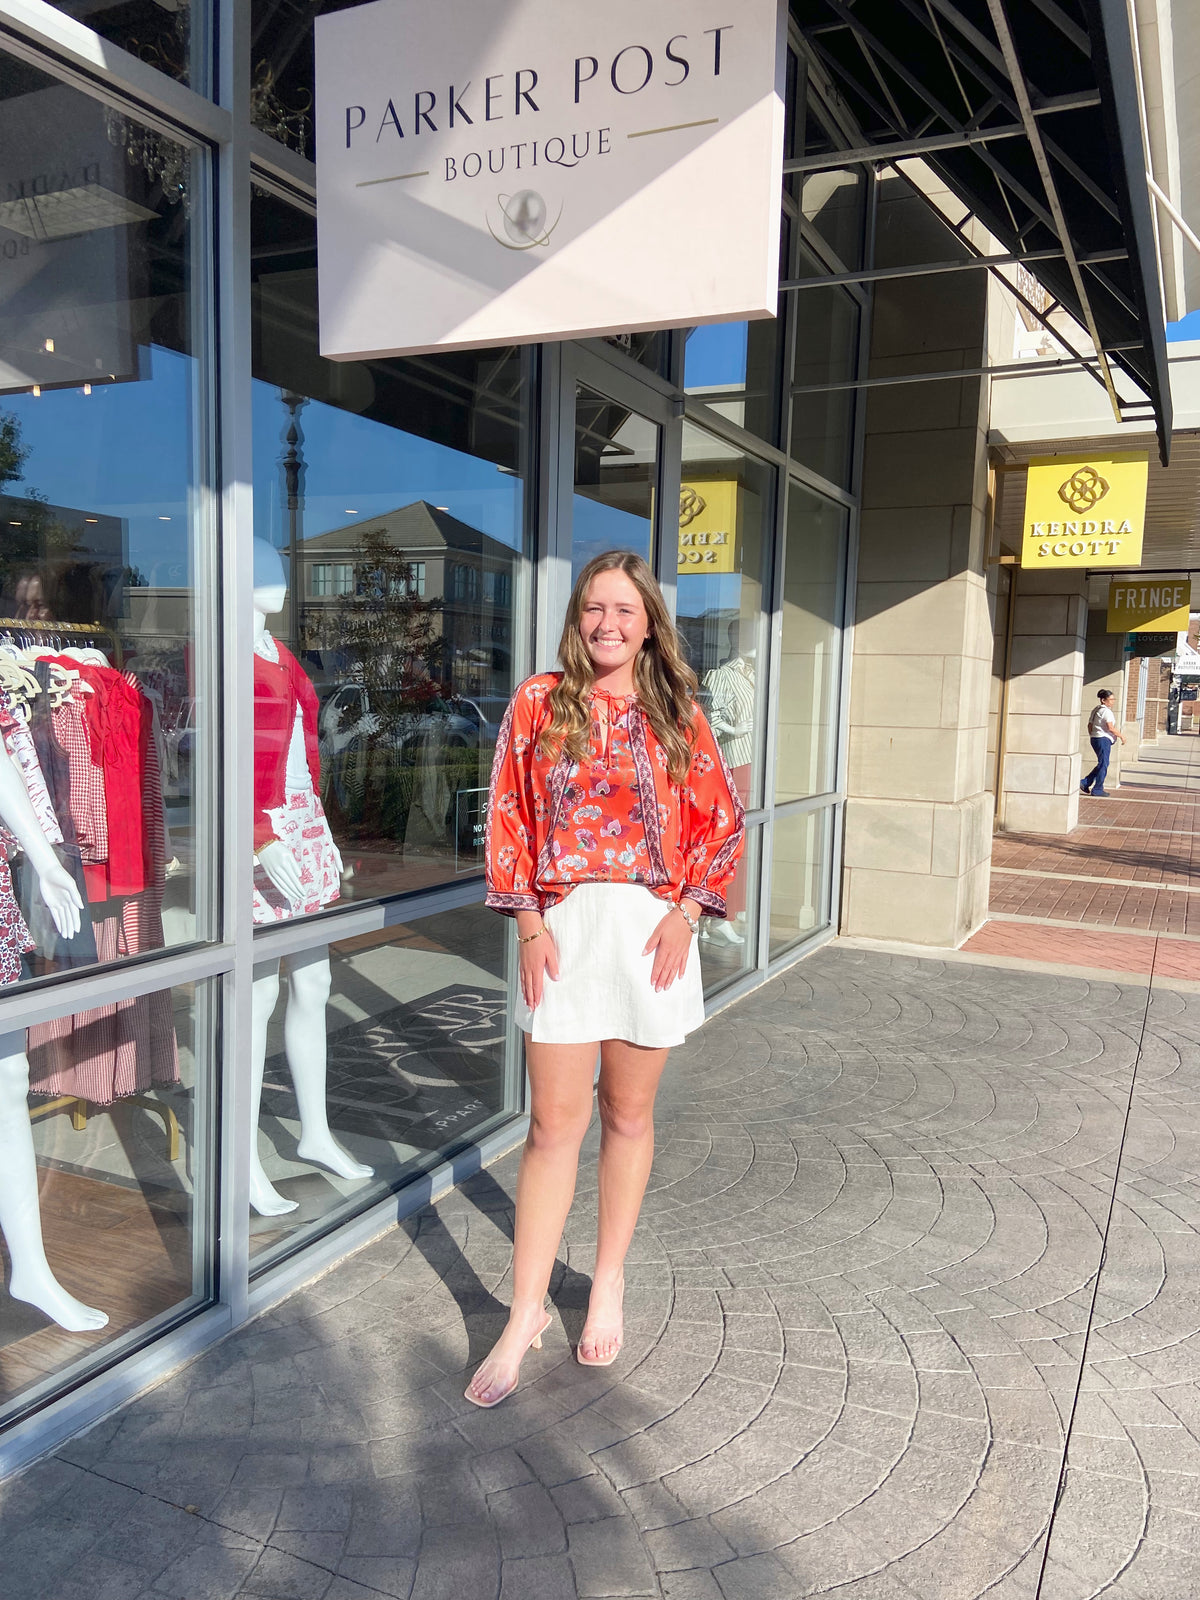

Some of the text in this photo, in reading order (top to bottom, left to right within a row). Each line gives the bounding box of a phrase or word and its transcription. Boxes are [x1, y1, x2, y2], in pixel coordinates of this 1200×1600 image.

[344, 24, 735, 149] PARKER POST
[443, 126, 613, 183] BOUTIQUE
[1029, 520, 1133, 538] KENDRA
[1037, 539, 1122, 558] SCOTT
[1114, 586, 1185, 609] FRINGE
[1137, 634, 1175, 642] LOVESAC
